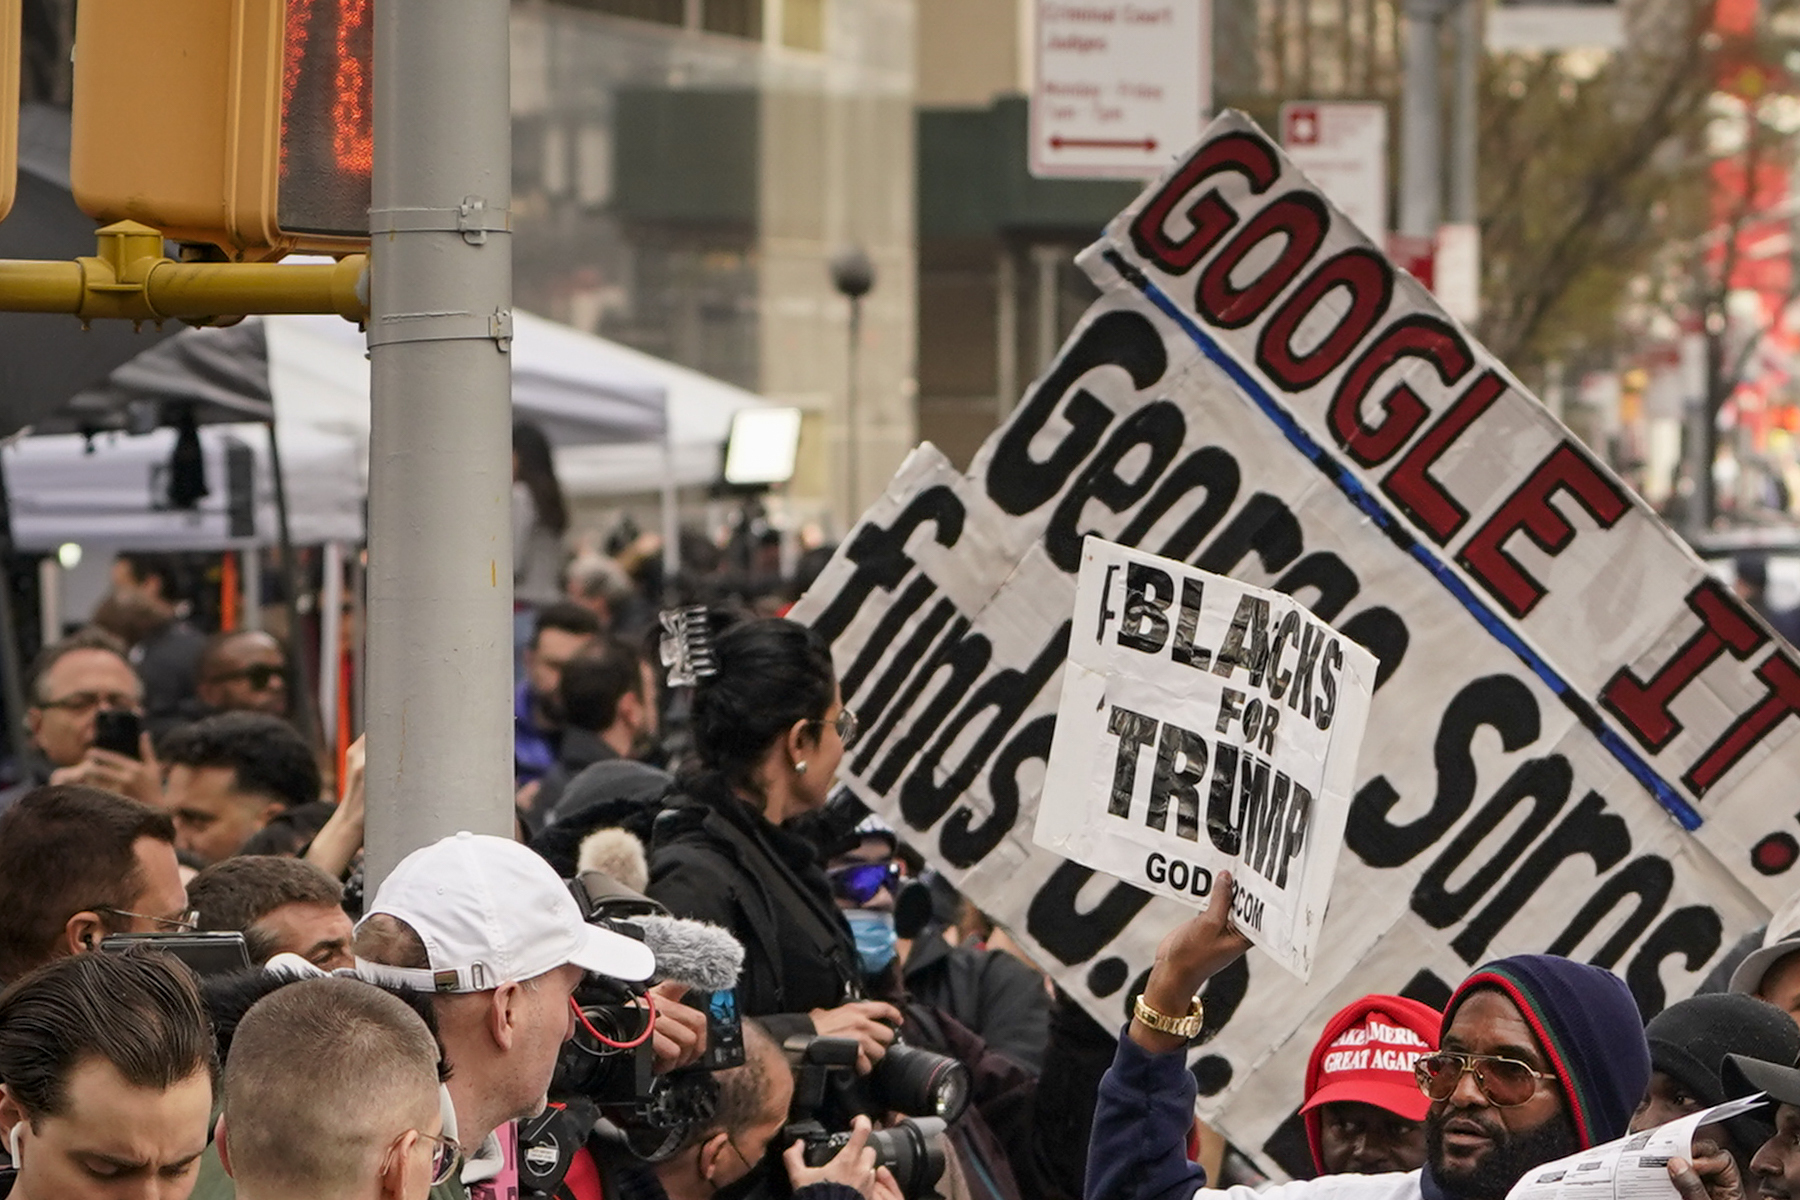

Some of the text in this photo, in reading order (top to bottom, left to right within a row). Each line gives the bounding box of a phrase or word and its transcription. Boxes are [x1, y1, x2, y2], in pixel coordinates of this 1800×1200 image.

[1128, 131, 1633, 619] GOOGLE
[1117, 562, 1342, 731] BLACKS
[1215, 687, 1279, 756] FOR
[1107, 705, 1312, 889] TRUMP
[1324, 1049, 1371, 1073] GREAT
[1331, 1021, 1429, 1047] AKE AMERIC
